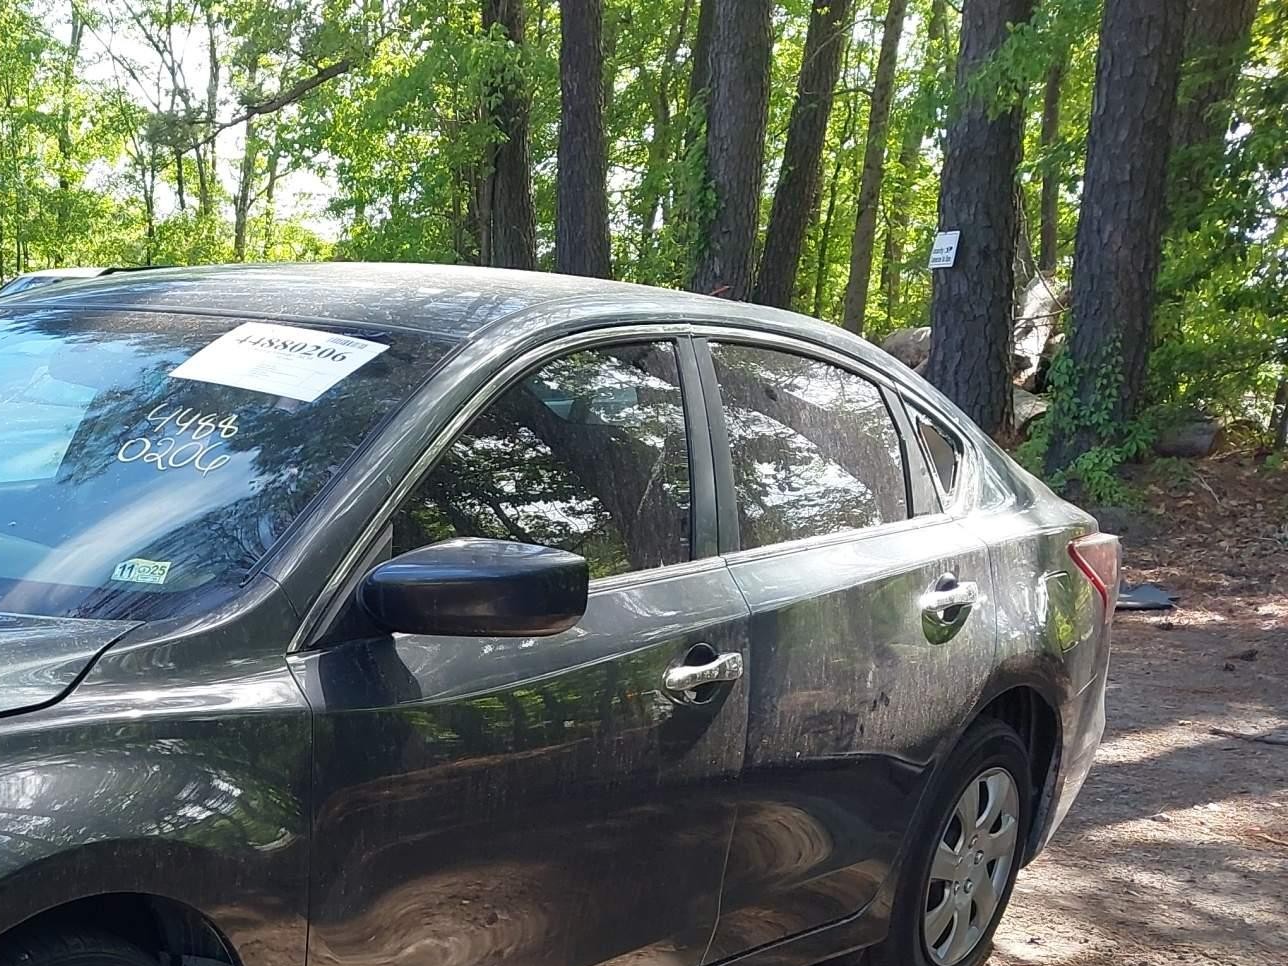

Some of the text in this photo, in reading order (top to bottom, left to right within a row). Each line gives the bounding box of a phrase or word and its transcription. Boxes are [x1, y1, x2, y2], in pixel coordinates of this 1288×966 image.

[235, 335, 348, 363] 44880206
[148, 402, 239, 440] 4488
[118, 437, 232, 478] 0206
[118, 563, 135, 578] 11
[150, 564, 167, 576] 25
